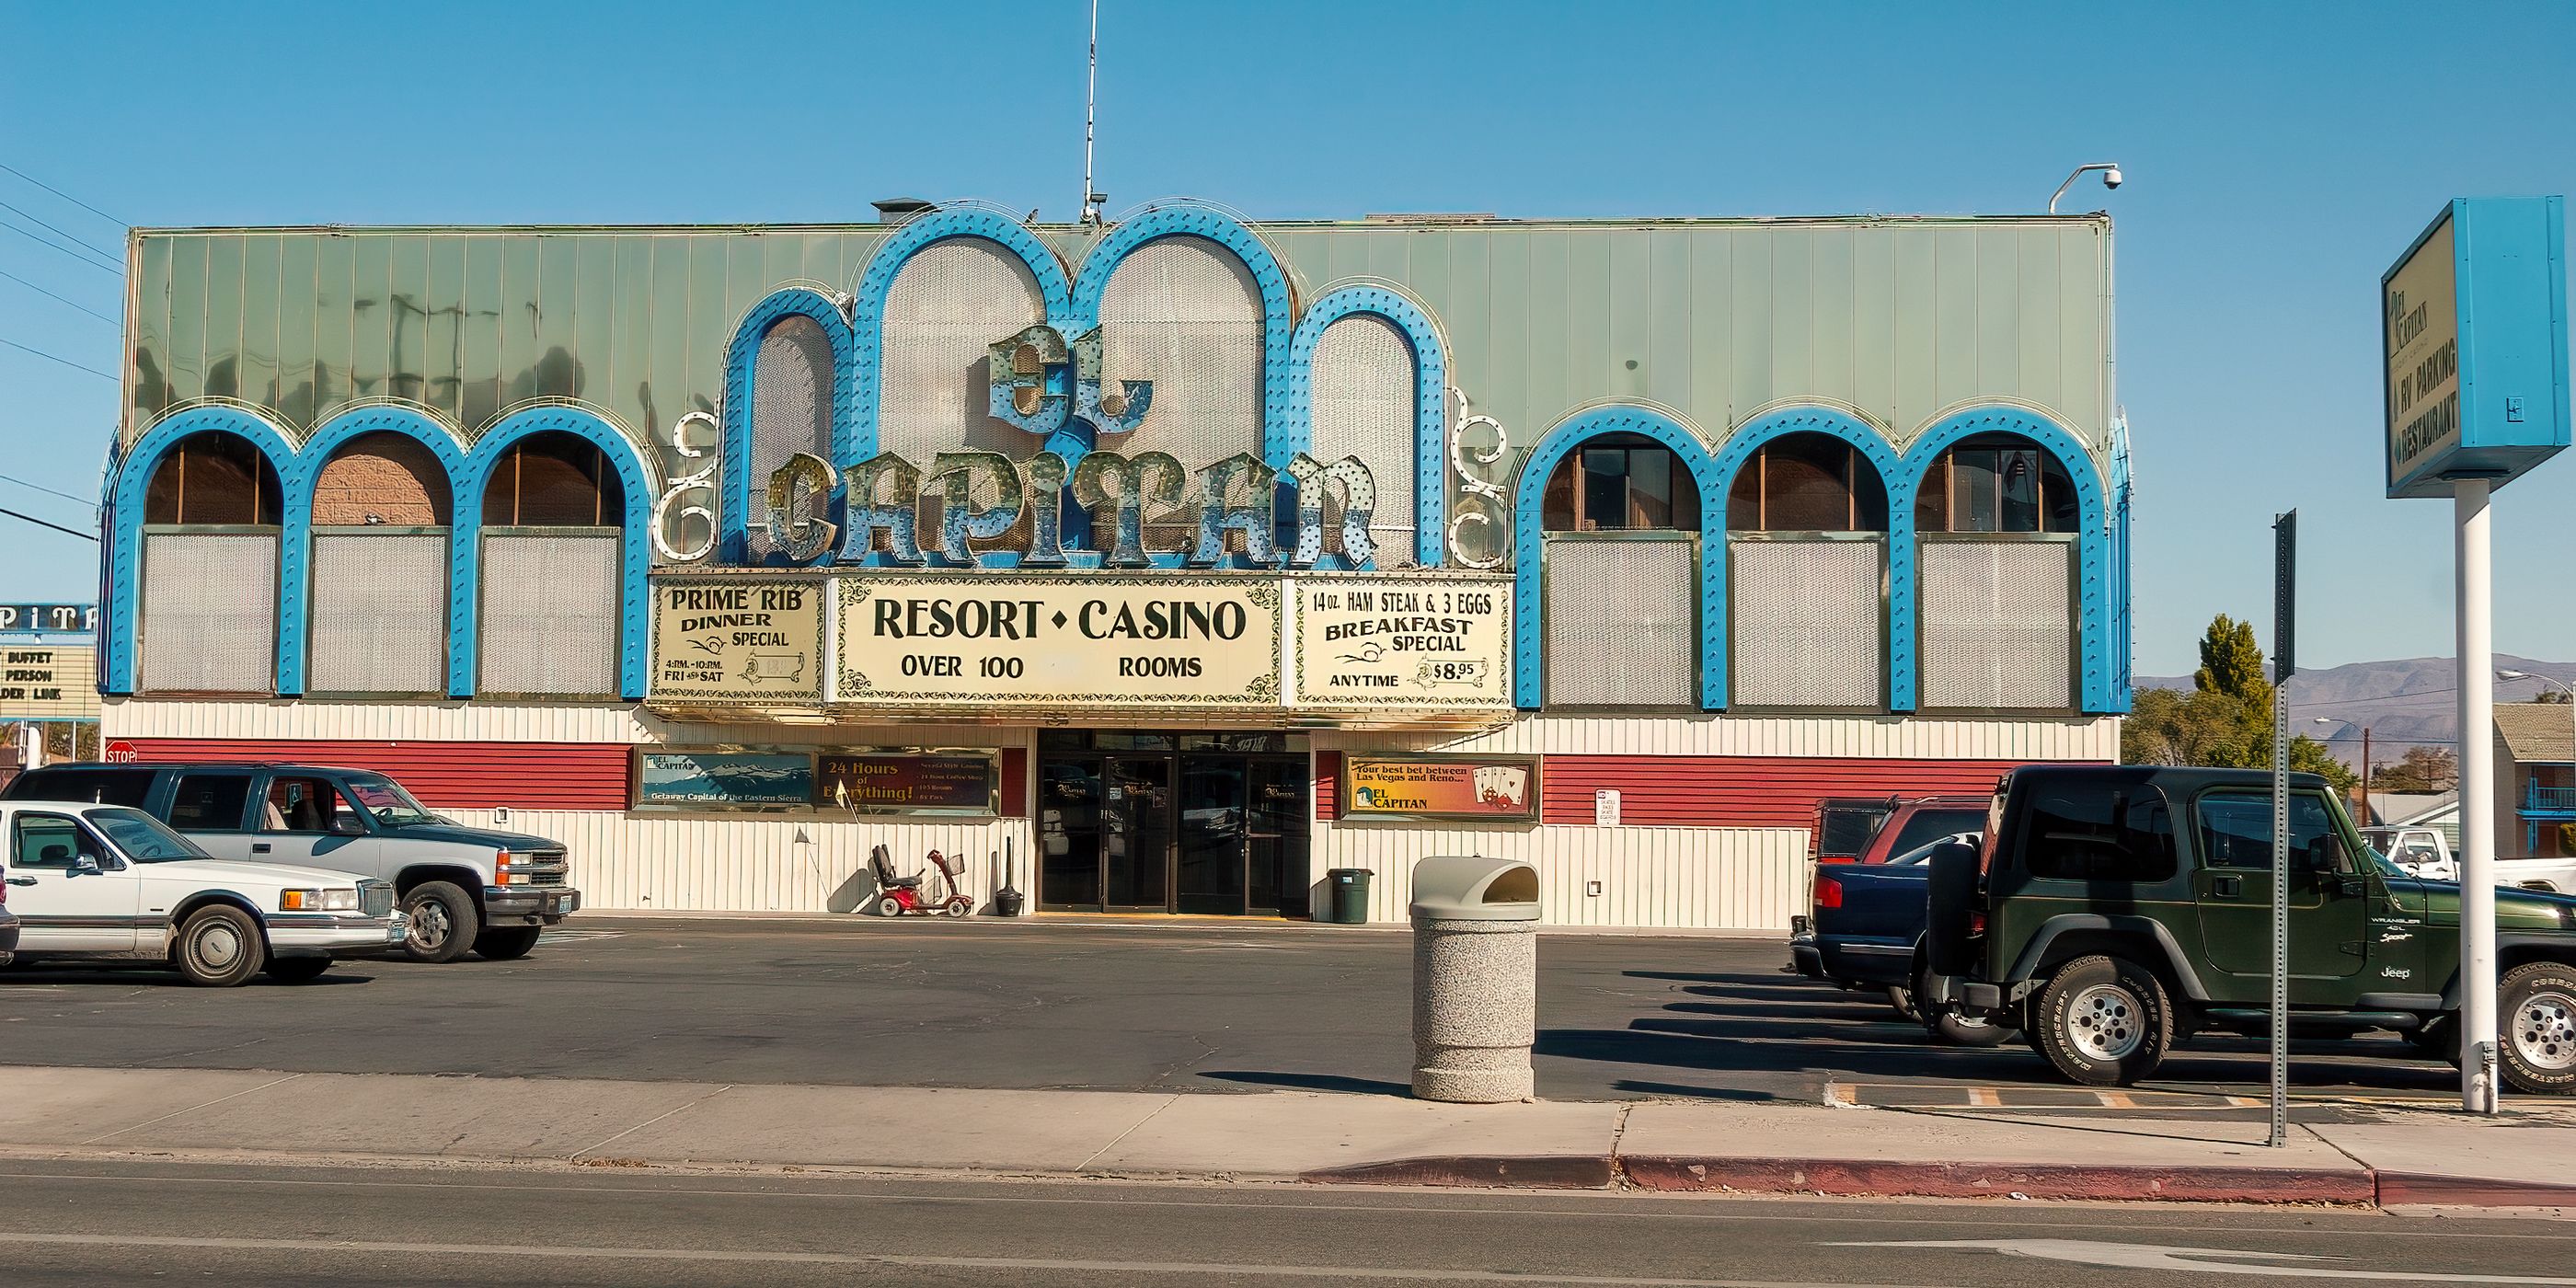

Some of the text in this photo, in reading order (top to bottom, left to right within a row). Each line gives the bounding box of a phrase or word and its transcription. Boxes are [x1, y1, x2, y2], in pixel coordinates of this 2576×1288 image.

[989, 324, 1154, 435] EL
[2401, 338, 2455, 414] RV PARKING
[2401, 391, 2456, 465] RESTAURANT
[765, 451, 1378, 569] CAPITAN
[672, 589, 802, 611] PRIME RIB
[1314, 592, 1325, 612] 14
[1348, 592, 1373, 613] HAM
[1382, 592, 1419, 613] STEAK
[1426, 593, 1436, 613] &
[1443, 592, 1451, 614] 3
[1458, 593, 1491, 615] EGGS
[681, 613, 772, 633] DINNER
[873, 600, 1247, 641] RESORT CASINO
[1325, 616, 1474, 641] BREAKFAST
[732, 632, 789, 647] SPECIAL
[1392, 636, 1466, 651] SPECIAL
[7, 651, 53, 663] BUFFET
[902, 655, 1202, 679] OVER 100 ROOMS
[1433, 662, 1474, 681] $8.95
[6, 670, 52, 682] PERSON
[664, 671, 684, 681] FRI
[700, 672, 724, 683] SAT
[1329, 675, 1398, 686] ANYTIME
[33, 688, 61, 700] LINK
[107, 751, 135, 763] STOP
[828, 762, 898, 775] 24 Hours
[1357, 765, 1467, 775] Your best bet between
[857, 776, 868, 785] of
[1356, 773, 1373, 781] Las
[1376, 773, 1405, 783] Vegas
[1408, 774, 1426, 782] and
[651, 793, 686, 801] Getaway
[688, 793, 716, 801] Capital
[1374, 789, 1388, 799] EL
[1373, 799, 1427, 809] CAPITAN
[2379, 933, 2413, 942] Sport
[2381, 967, 2410, 979] Jeep
